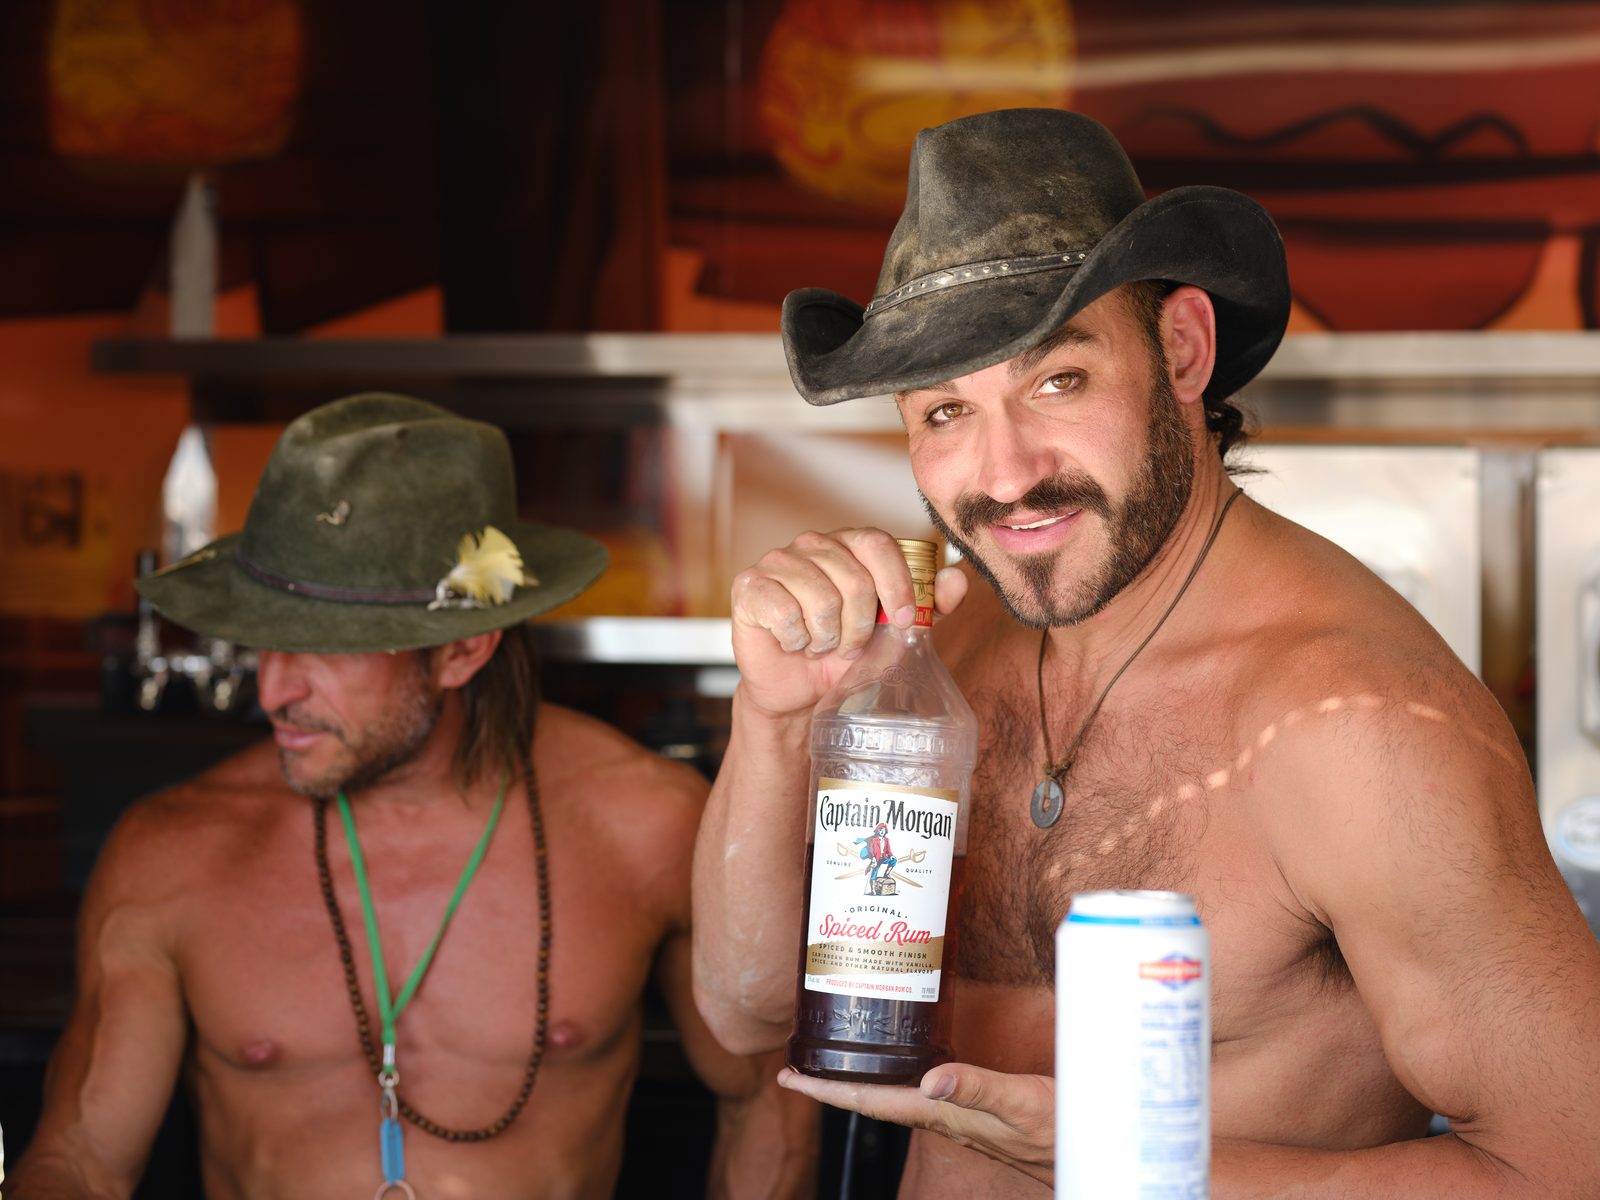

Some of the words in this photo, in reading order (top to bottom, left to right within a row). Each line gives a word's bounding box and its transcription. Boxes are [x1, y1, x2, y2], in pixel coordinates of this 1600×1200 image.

[820, 795, 881, 832] Captain
[883, 799, 952, 840] Morgan
[905, 867, 933, 875] QUALITY
[849, 905, 902, 918] ORIGINAL
[819, 914, 883, 940] Spiced
[884, 921, 932, 947] Rum
[811, 951, 843, 960] CARIBBEAN
[818, 943, 845, 952] SPICED
[857, 947, 895, 957] SMOOTH
[898, 951, 928, 960] FINISH
[845, 962, 868, 970] OTHER
[871, 965, 904, 973] NATURAL
[906, 967, 933, 975] FLAVORS
[826, 978, 848, 988] PRODUCED
[855, 982, 875, 990] CAPTAIN
[875, 984, 895, 992] MORGAN
